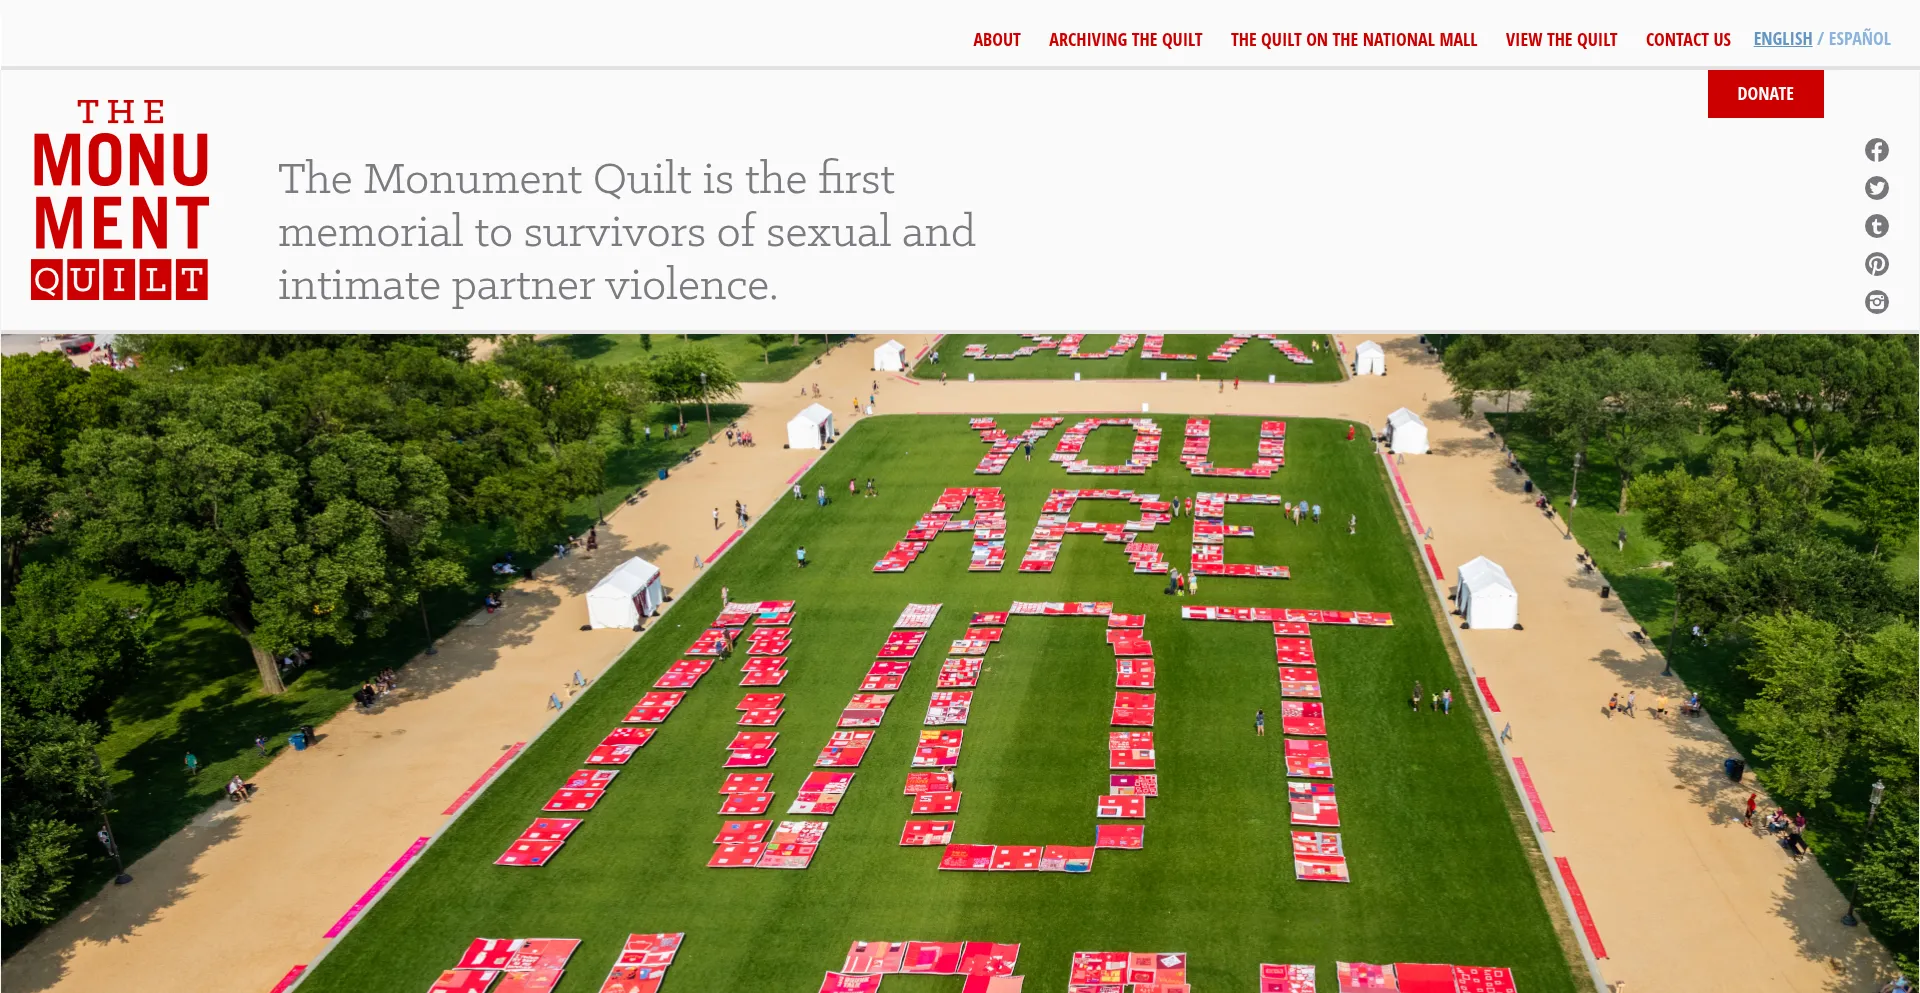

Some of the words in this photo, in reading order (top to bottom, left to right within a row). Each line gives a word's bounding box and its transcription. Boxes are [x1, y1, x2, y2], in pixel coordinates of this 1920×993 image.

[973, 32, 1021, 47] ABOUT
[1049, 32, 1127, 47] ARCHIVING
[1131, 32, 1158, 47] THE
[1161, 32, 1204, 50] QUILT
[1230, 32, 1257, 47] THE
[1260, 32, 1303, 50] QUILT
[1306, 32, 1328, 47] ON
[1331, 32, 1359, 47] THE
[1363, 32, 1436, 47] NATIONAL
[1439, 32, 1478, 47] MALL
[1505, 32, 1544, 47] VIEW
[1546, 32, 1573, 47] THE
[1576, 32, 1619, 50] QUILT
[1645, 32, 1710, 47] CONTACT
[1713, 32, 1732, 47] US
[1753, 31, 1814, 48] ENGLISH
[1816, 31, 1825, 46] /
[1829, 27, 1892, 46] ESPAÑOL
[1738, 86, 1794, 101] DONATE
[76, 99, 164, 125] THE
[33, 132, 209, 187] MONU
[278, 158, 352, 195] The
[364, 163, 583, 195] Monument
[594, 158, 692, 200] Quilt
[703, 162, 733, 195] is
[745, 158, 807, 195] the
[818, 157, 895, 195] first
[35, 195, 210, 250] MENT
[278, 211, 464, 248] memorial
[474, 219, 512, 248] to
[525, 215, 705, 248] survivors
[717, 210, 757, 248] of
[767, 211, 892, 248] sexual
[903, 211, 976, 248] and
[34, 265, 206, 297] QUILT
[278, 268, 440, 301] intimate
[451, 272, 596, 310] partner
[604, 264, 777, 301] violence.
[969, 417, 1287, 478] YOU
[872, 487, 1291, 579] ARE
[493, 600, 1395, 883] NOT
